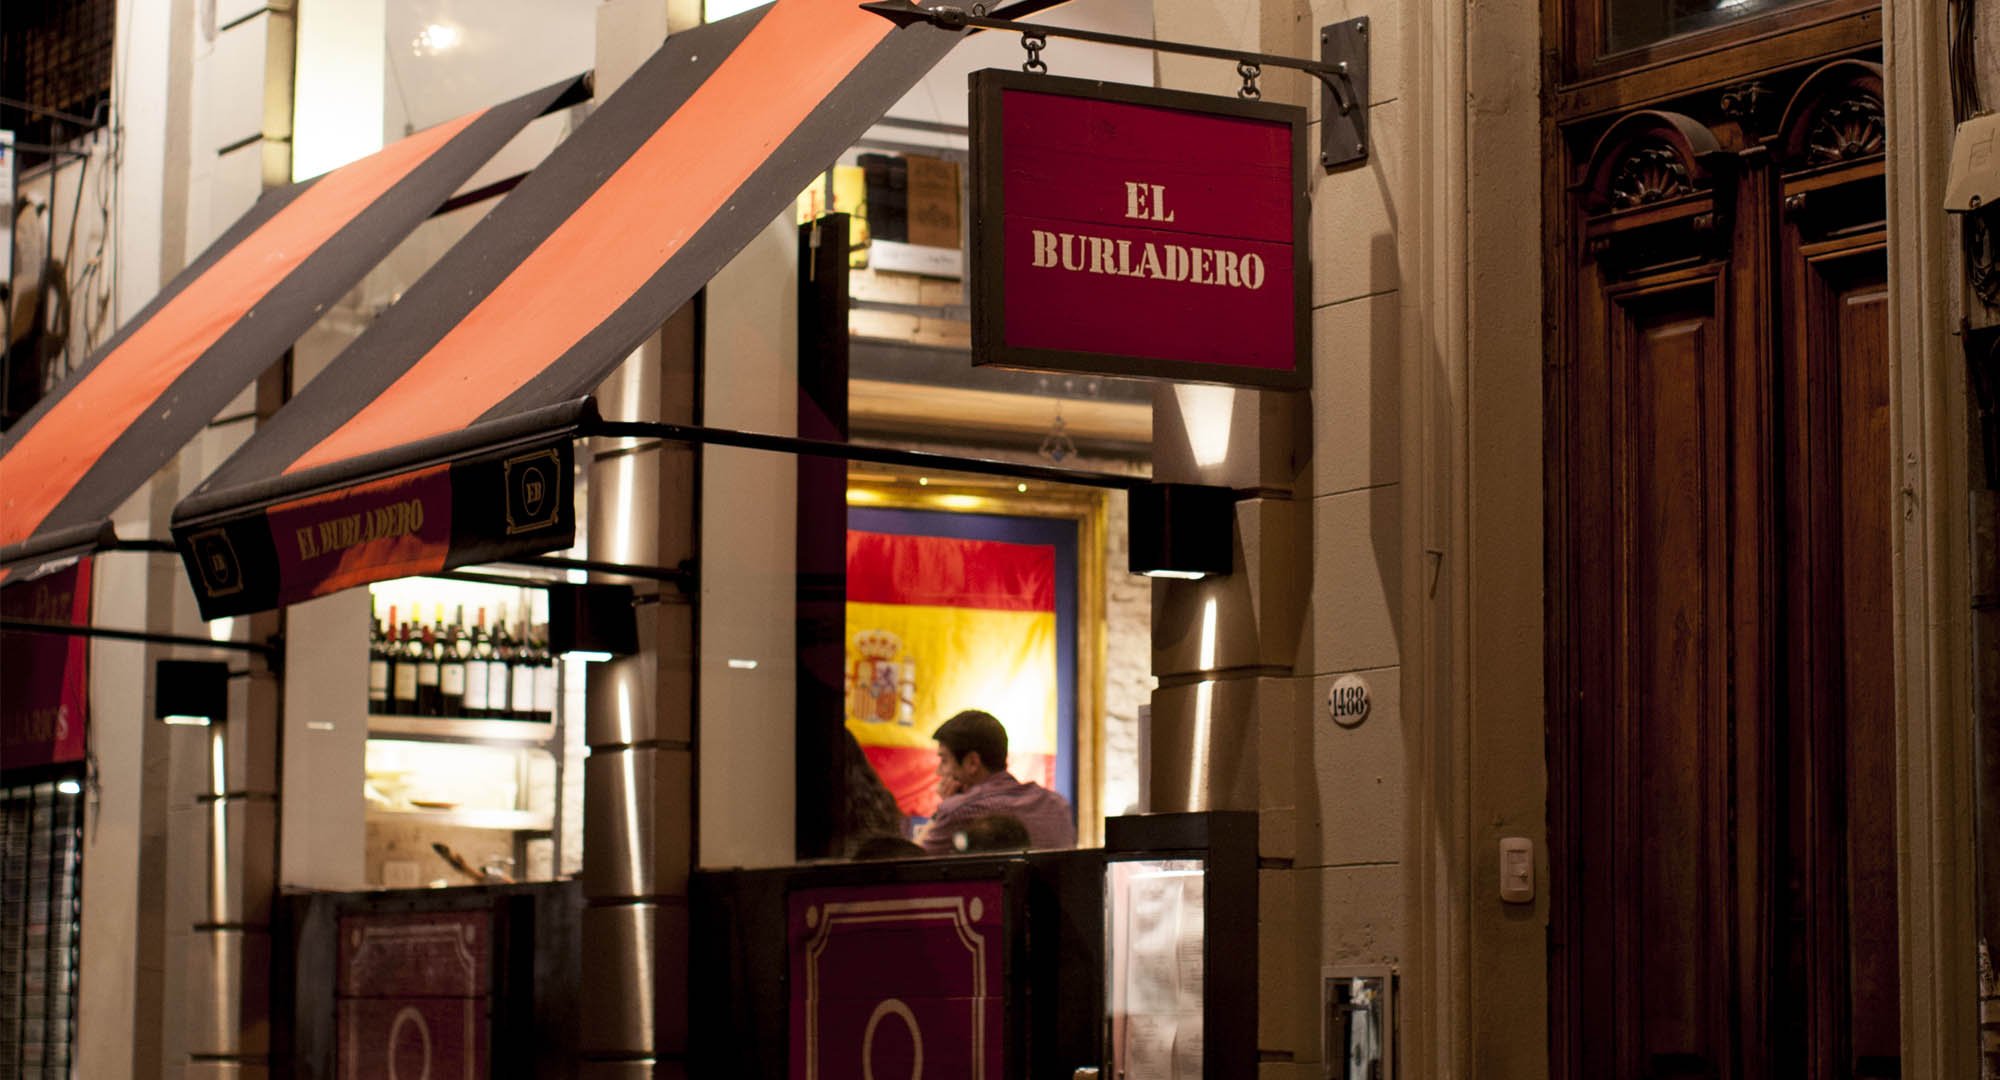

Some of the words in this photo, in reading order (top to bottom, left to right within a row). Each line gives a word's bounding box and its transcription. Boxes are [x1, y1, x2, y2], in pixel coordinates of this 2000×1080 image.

[1124, 181, 1175, 222] EL
[1032, 229, 1265, 290] BURLADERO
[296, 526, 320, 561] EL
[318, 498, 424, 555] BURLADERO
[1333, 686, 1365, 717] 1488
